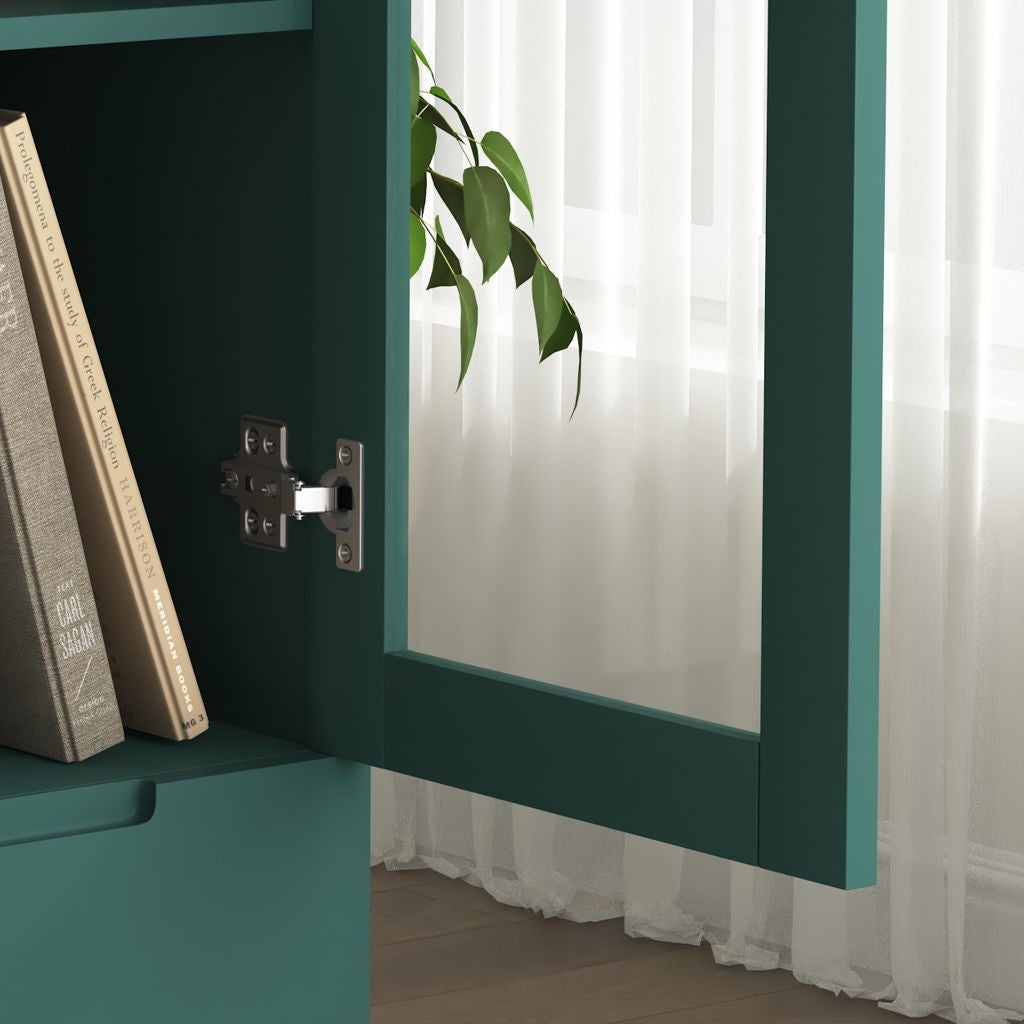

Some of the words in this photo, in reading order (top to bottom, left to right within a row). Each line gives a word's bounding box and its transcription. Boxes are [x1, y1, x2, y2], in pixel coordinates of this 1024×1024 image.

[15, 130, 49, 231] Prolegomena
[45, 235, 55, 253] to
[52, 257, 65, 283] the
[61, 288, 82, 328] study
[76, 334, 89, 350] of
[82, 355, 103, 401] Greek
[96, 406, 120, 471] Religion
[119, 478, 157, 579] HARRISON
[56, 592, 85, 628] CARL
[59, 619, 96, 660] SAGAN
[152, 588, 179, 660] MERIDIAN
[175, 664, 194, 713] BOOKS
